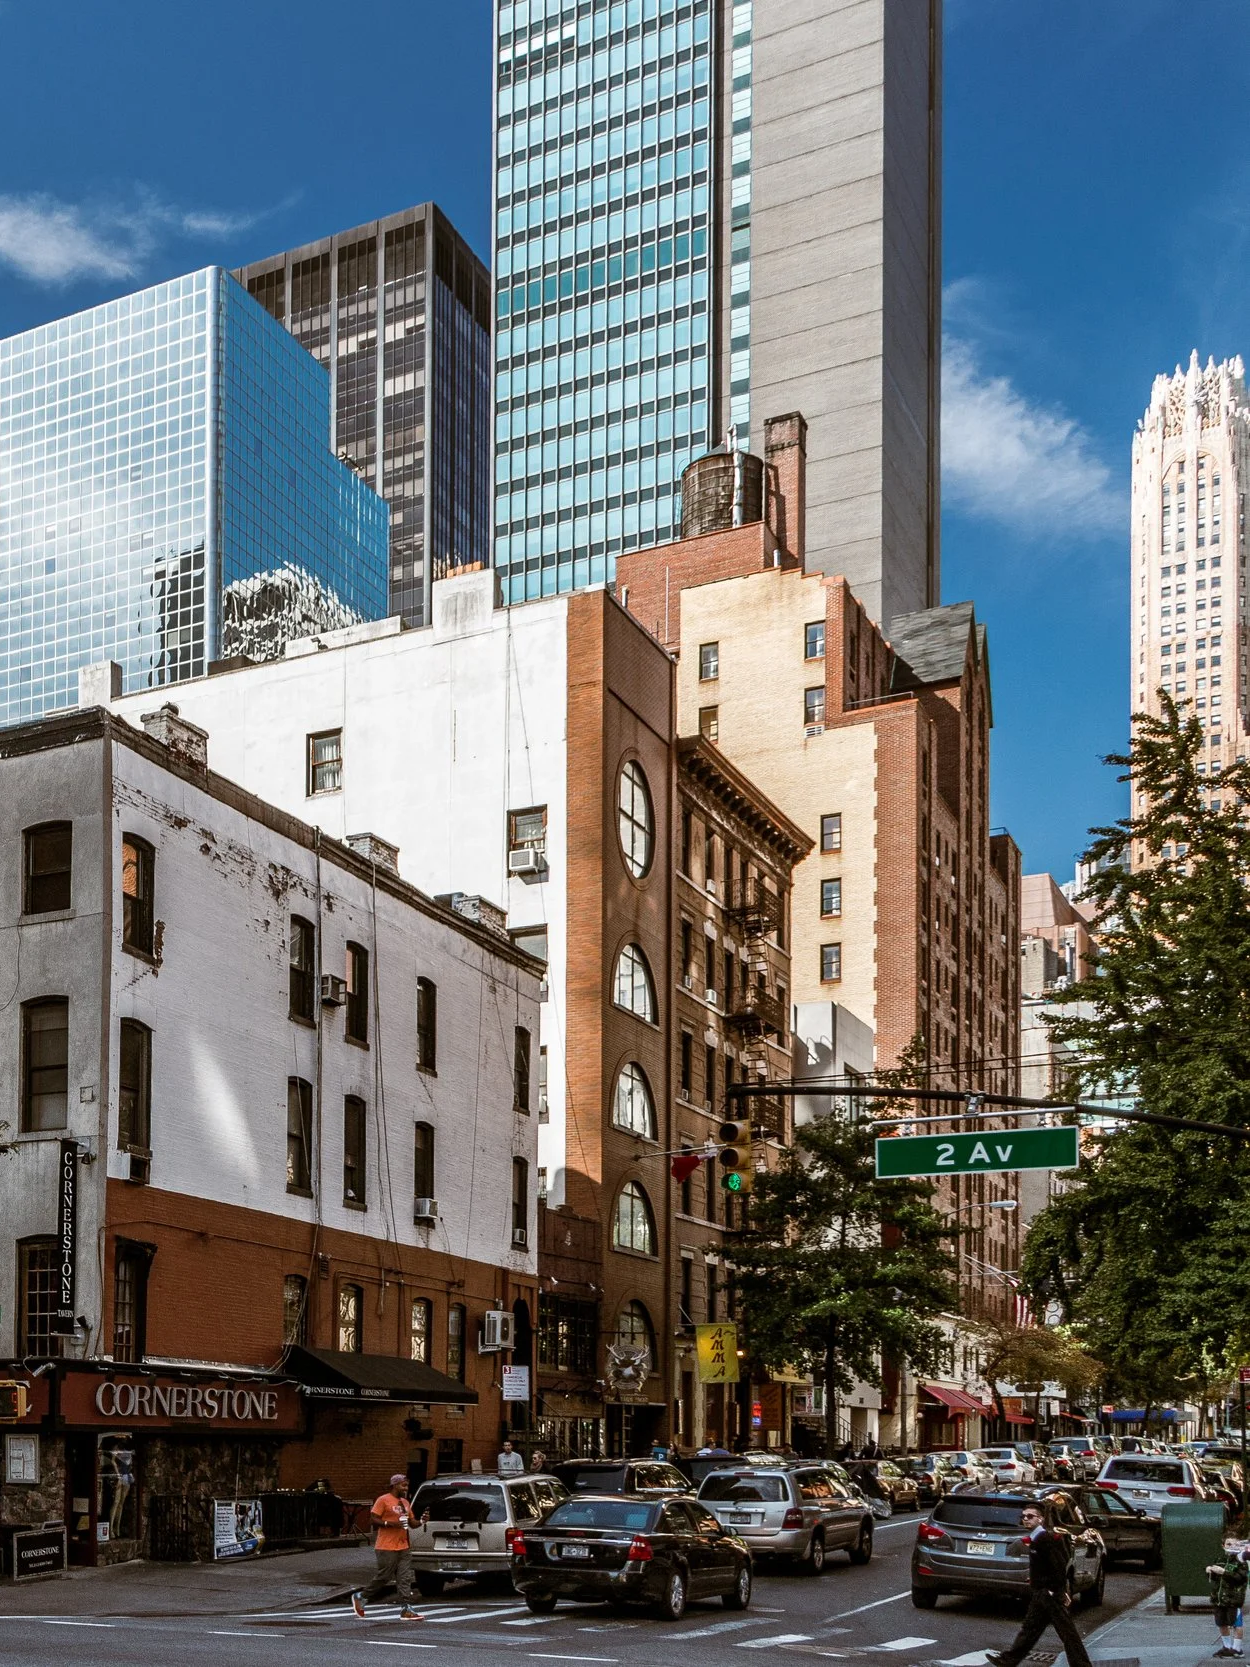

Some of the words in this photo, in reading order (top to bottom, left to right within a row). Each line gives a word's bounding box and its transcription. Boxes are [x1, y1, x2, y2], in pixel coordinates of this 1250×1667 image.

[936, 1143, 955, 1165] 2
[968, 1141, 1013, 1164] Av
[62, 1151, 74, 1304] CORNERSTONE
[710, 1327, 726, 1378] AMMA
[96, 1382, 278, 1420] CORNERSTONE
[21, 1546, 60, 1559] CORNERSTONE
